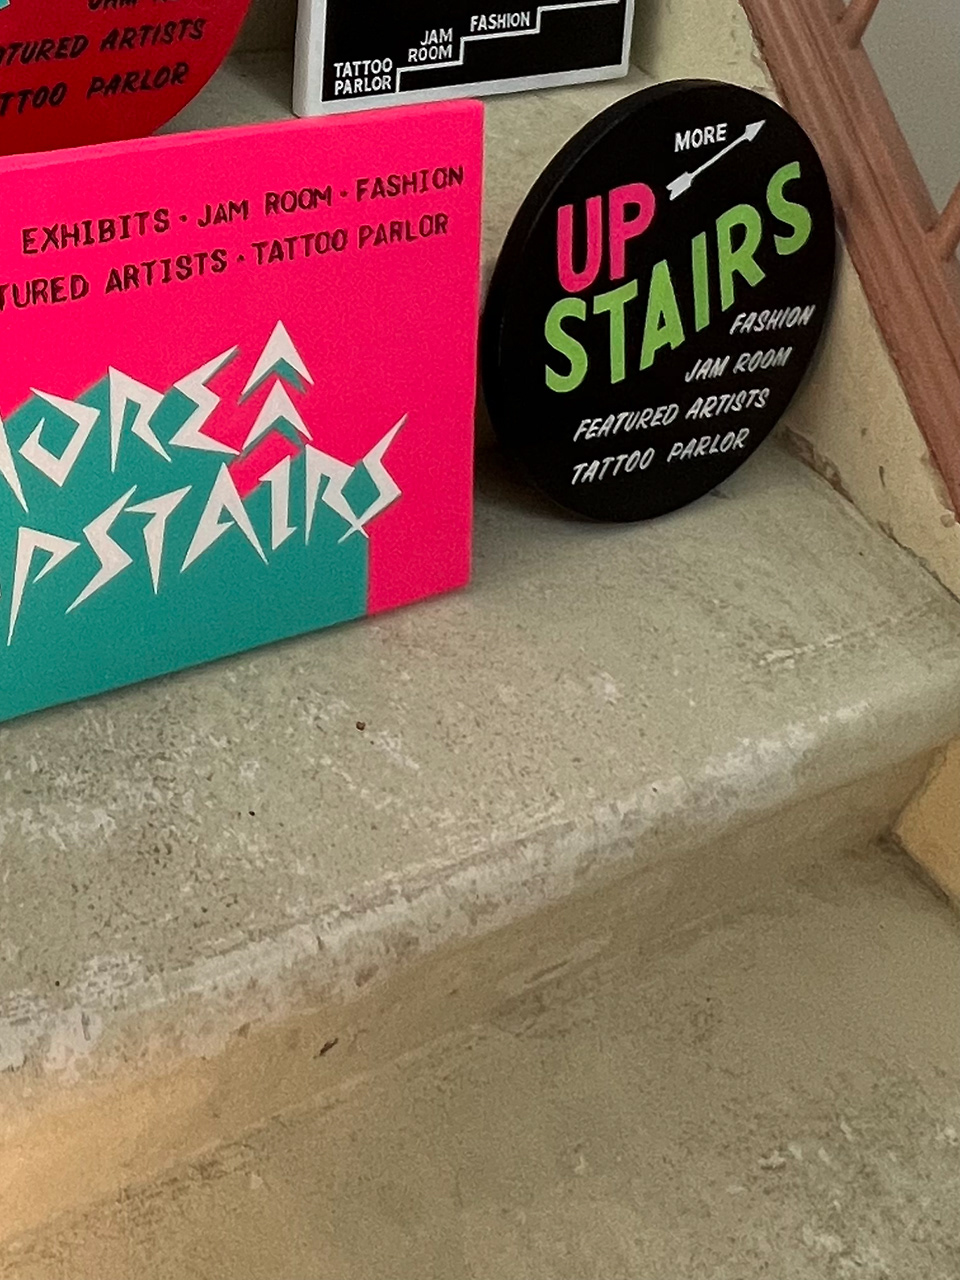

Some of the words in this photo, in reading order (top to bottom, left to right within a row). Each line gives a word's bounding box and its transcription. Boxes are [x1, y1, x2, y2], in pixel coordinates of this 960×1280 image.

[100, 18, 206, 52] ARTISTS
[420, 28, 453, 45] JAM
[470, 12, 530, 32] FASHION
[334, 58, 392, 78] TATTOO
[408, 45, 453, 62] ROOM
[87, 62, 190, 98] PARLOR
[334, 76, 392, 95] PARLOR
[674, 123, 727, 152] MORE
[21, 208, 170, 256] EXHIBITS
[197, 200, 250, 229] JAM
[265, 184, 332, 216] ROOM
[356, 165, 465, 203] FASHION
[105, 252, 228, 295] ARTISTS
[252, 228, 349, 266] TATTOO
[357, 212, 449, 250] PARLOR
[557, 182, 655, 293] UP
[545, 161, 812, 393] STAIRS
[730, 305, 816, 335] FASHION
[685, 354, 729, 383] JAM
[733, 346, 792, 375] ROOM
[573, 403, 679, 442] FEATURED
[685, 388, 770, 420] ARTISTS
[570, 448, 655, 486] TATTOO
[667, 428, 750, 463] PARLOR
